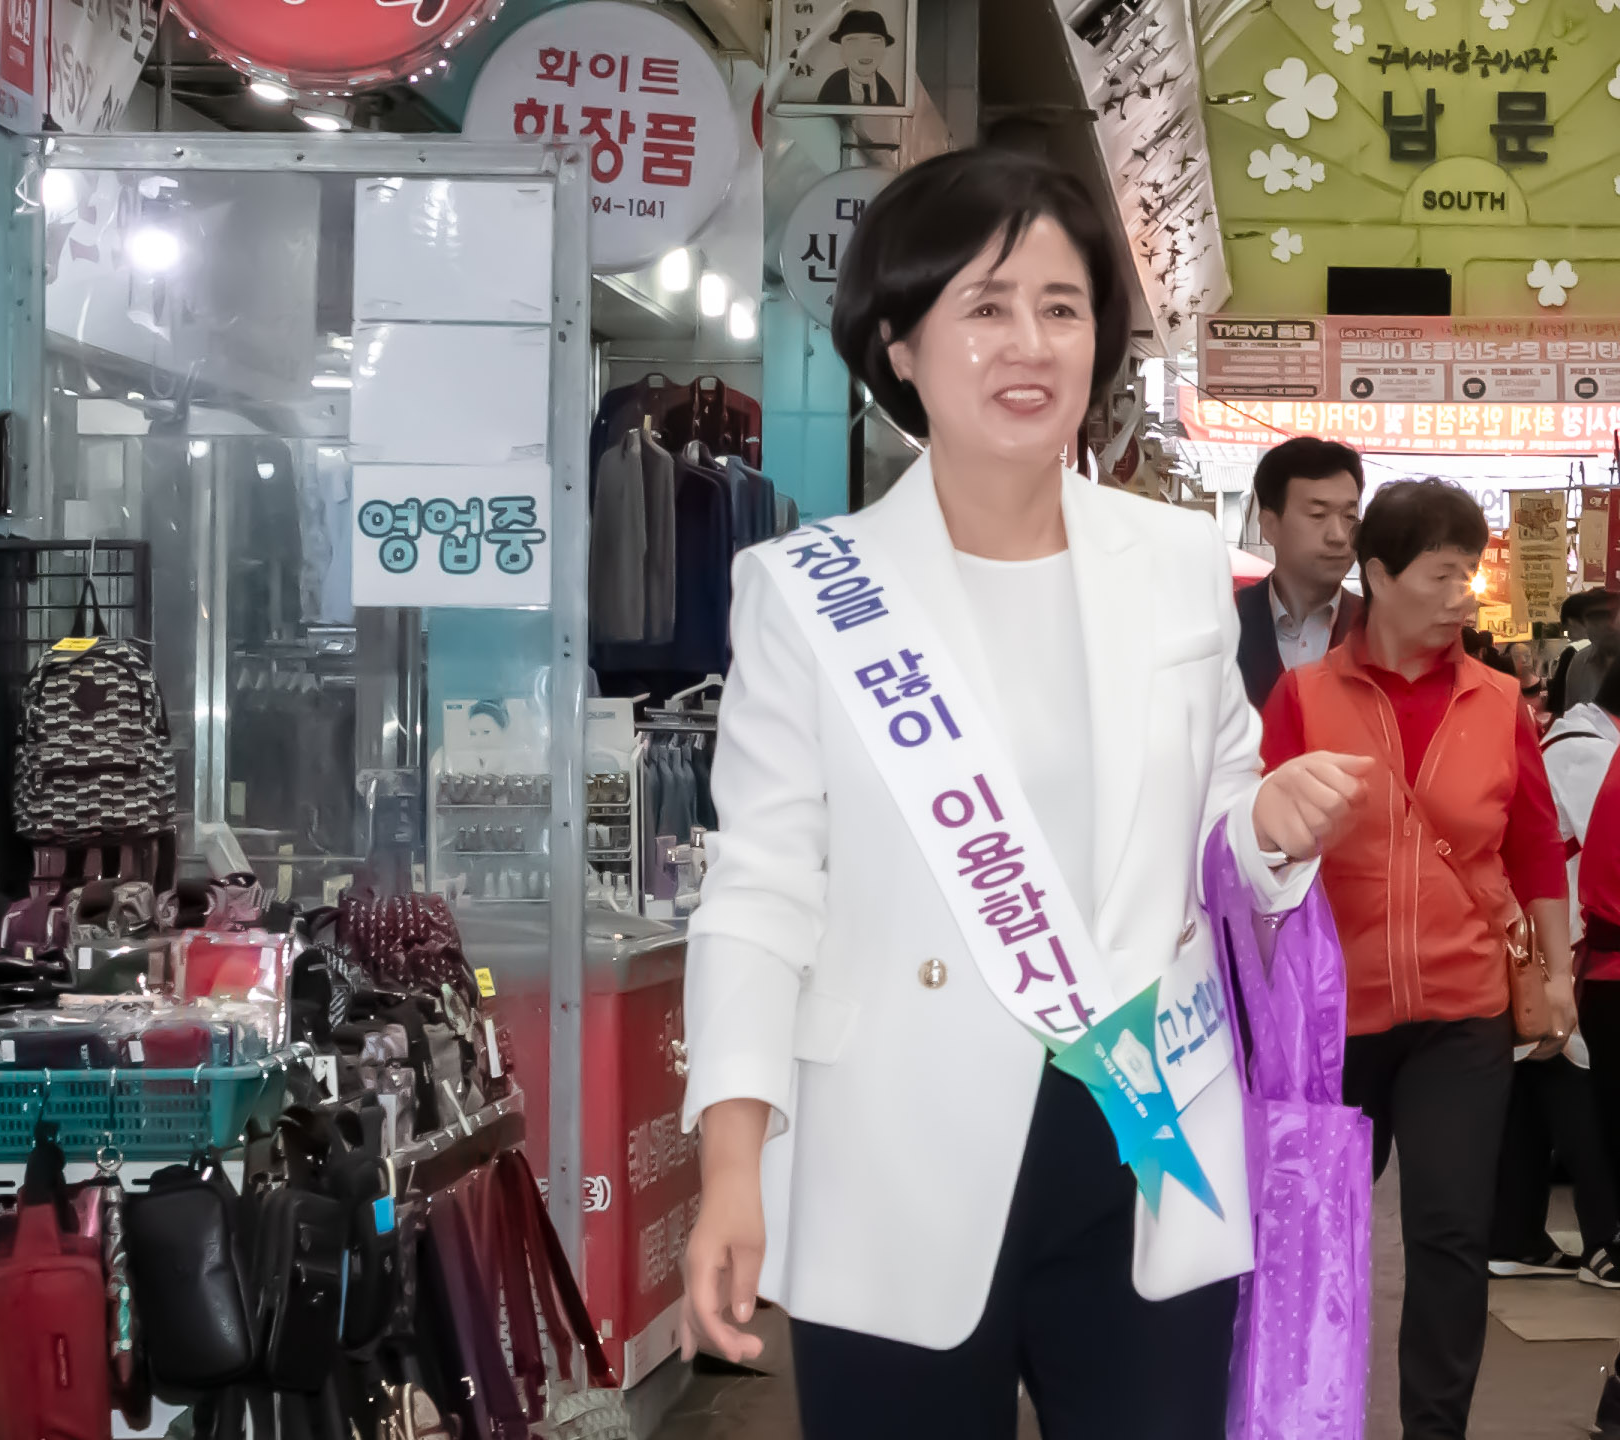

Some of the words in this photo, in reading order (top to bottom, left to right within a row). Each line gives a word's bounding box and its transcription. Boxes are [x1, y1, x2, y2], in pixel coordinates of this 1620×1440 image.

[534, 46, 680, 96] 화이트
[1383, 88, 1554, 163] 남문
[591, 197, 666, 220] 94-1041
[1423, 190, 1505, 210] SOUTH
[358, 497, 546, 575] 영업중
[854, 648, 963, 748] 많이
[932, 773, 1096, 1035] 이용합시다
